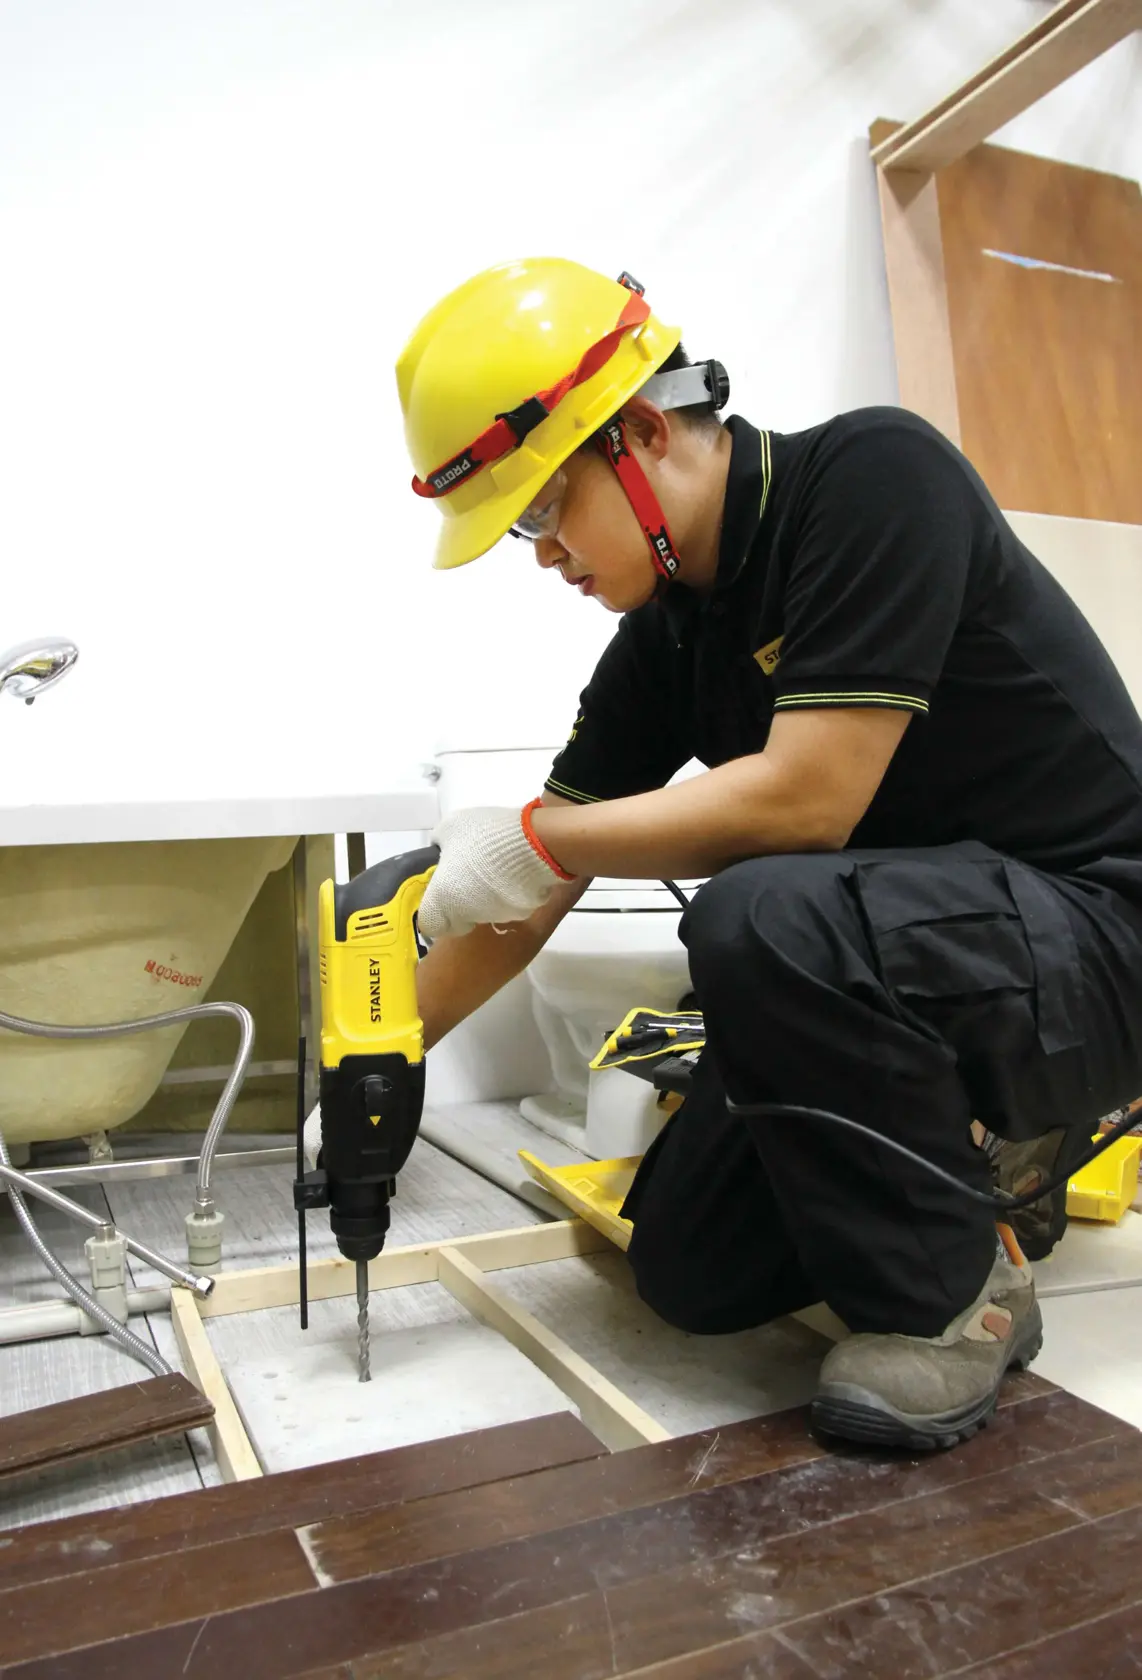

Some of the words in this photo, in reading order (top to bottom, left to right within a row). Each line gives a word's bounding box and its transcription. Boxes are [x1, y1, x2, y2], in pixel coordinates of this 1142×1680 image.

[434, 459, 471, 489] PROTO
[656, 537, 677, 575] OTO
[369, 958, 381, 1023] STANLEY
